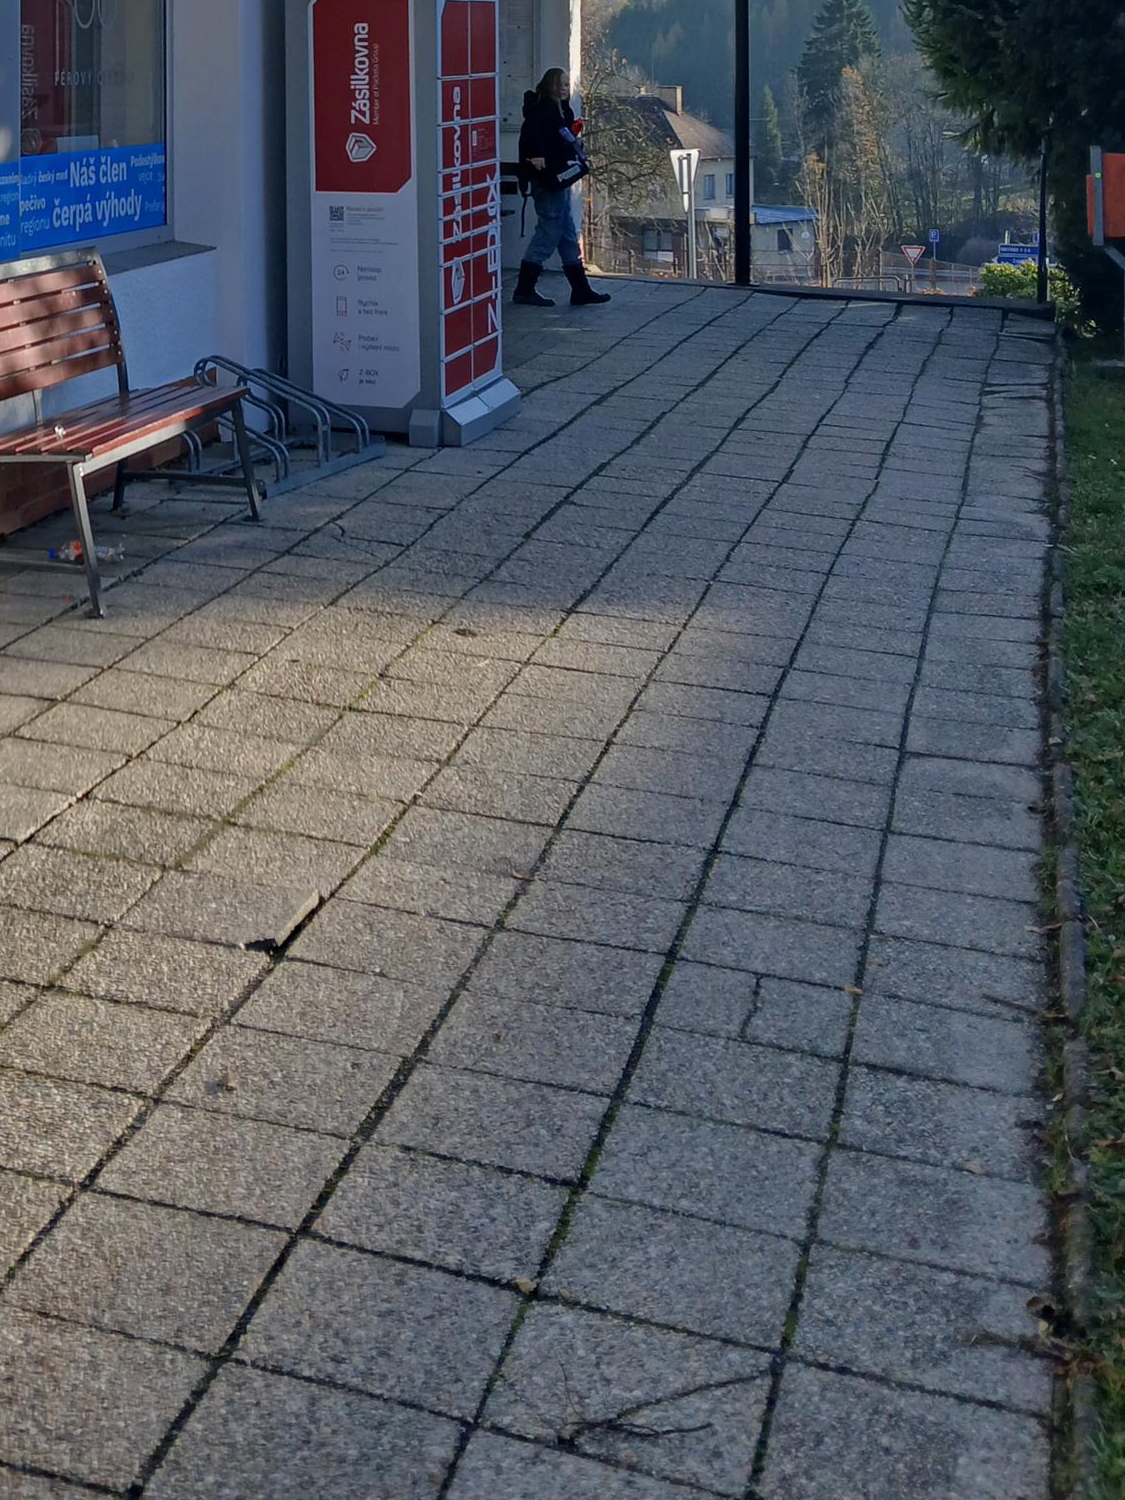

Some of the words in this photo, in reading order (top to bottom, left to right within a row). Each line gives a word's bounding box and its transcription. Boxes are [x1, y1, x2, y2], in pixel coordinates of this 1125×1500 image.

[351, 22, 370, 124] Zásilkovna
[70, 157, 95, 188] Náš
[99, 156, 127, 184] člen
[19, 195, 46, 216] pečivo
[53, 194, 93, 232] čerpá
[96, 189, 142, 227] výhody
